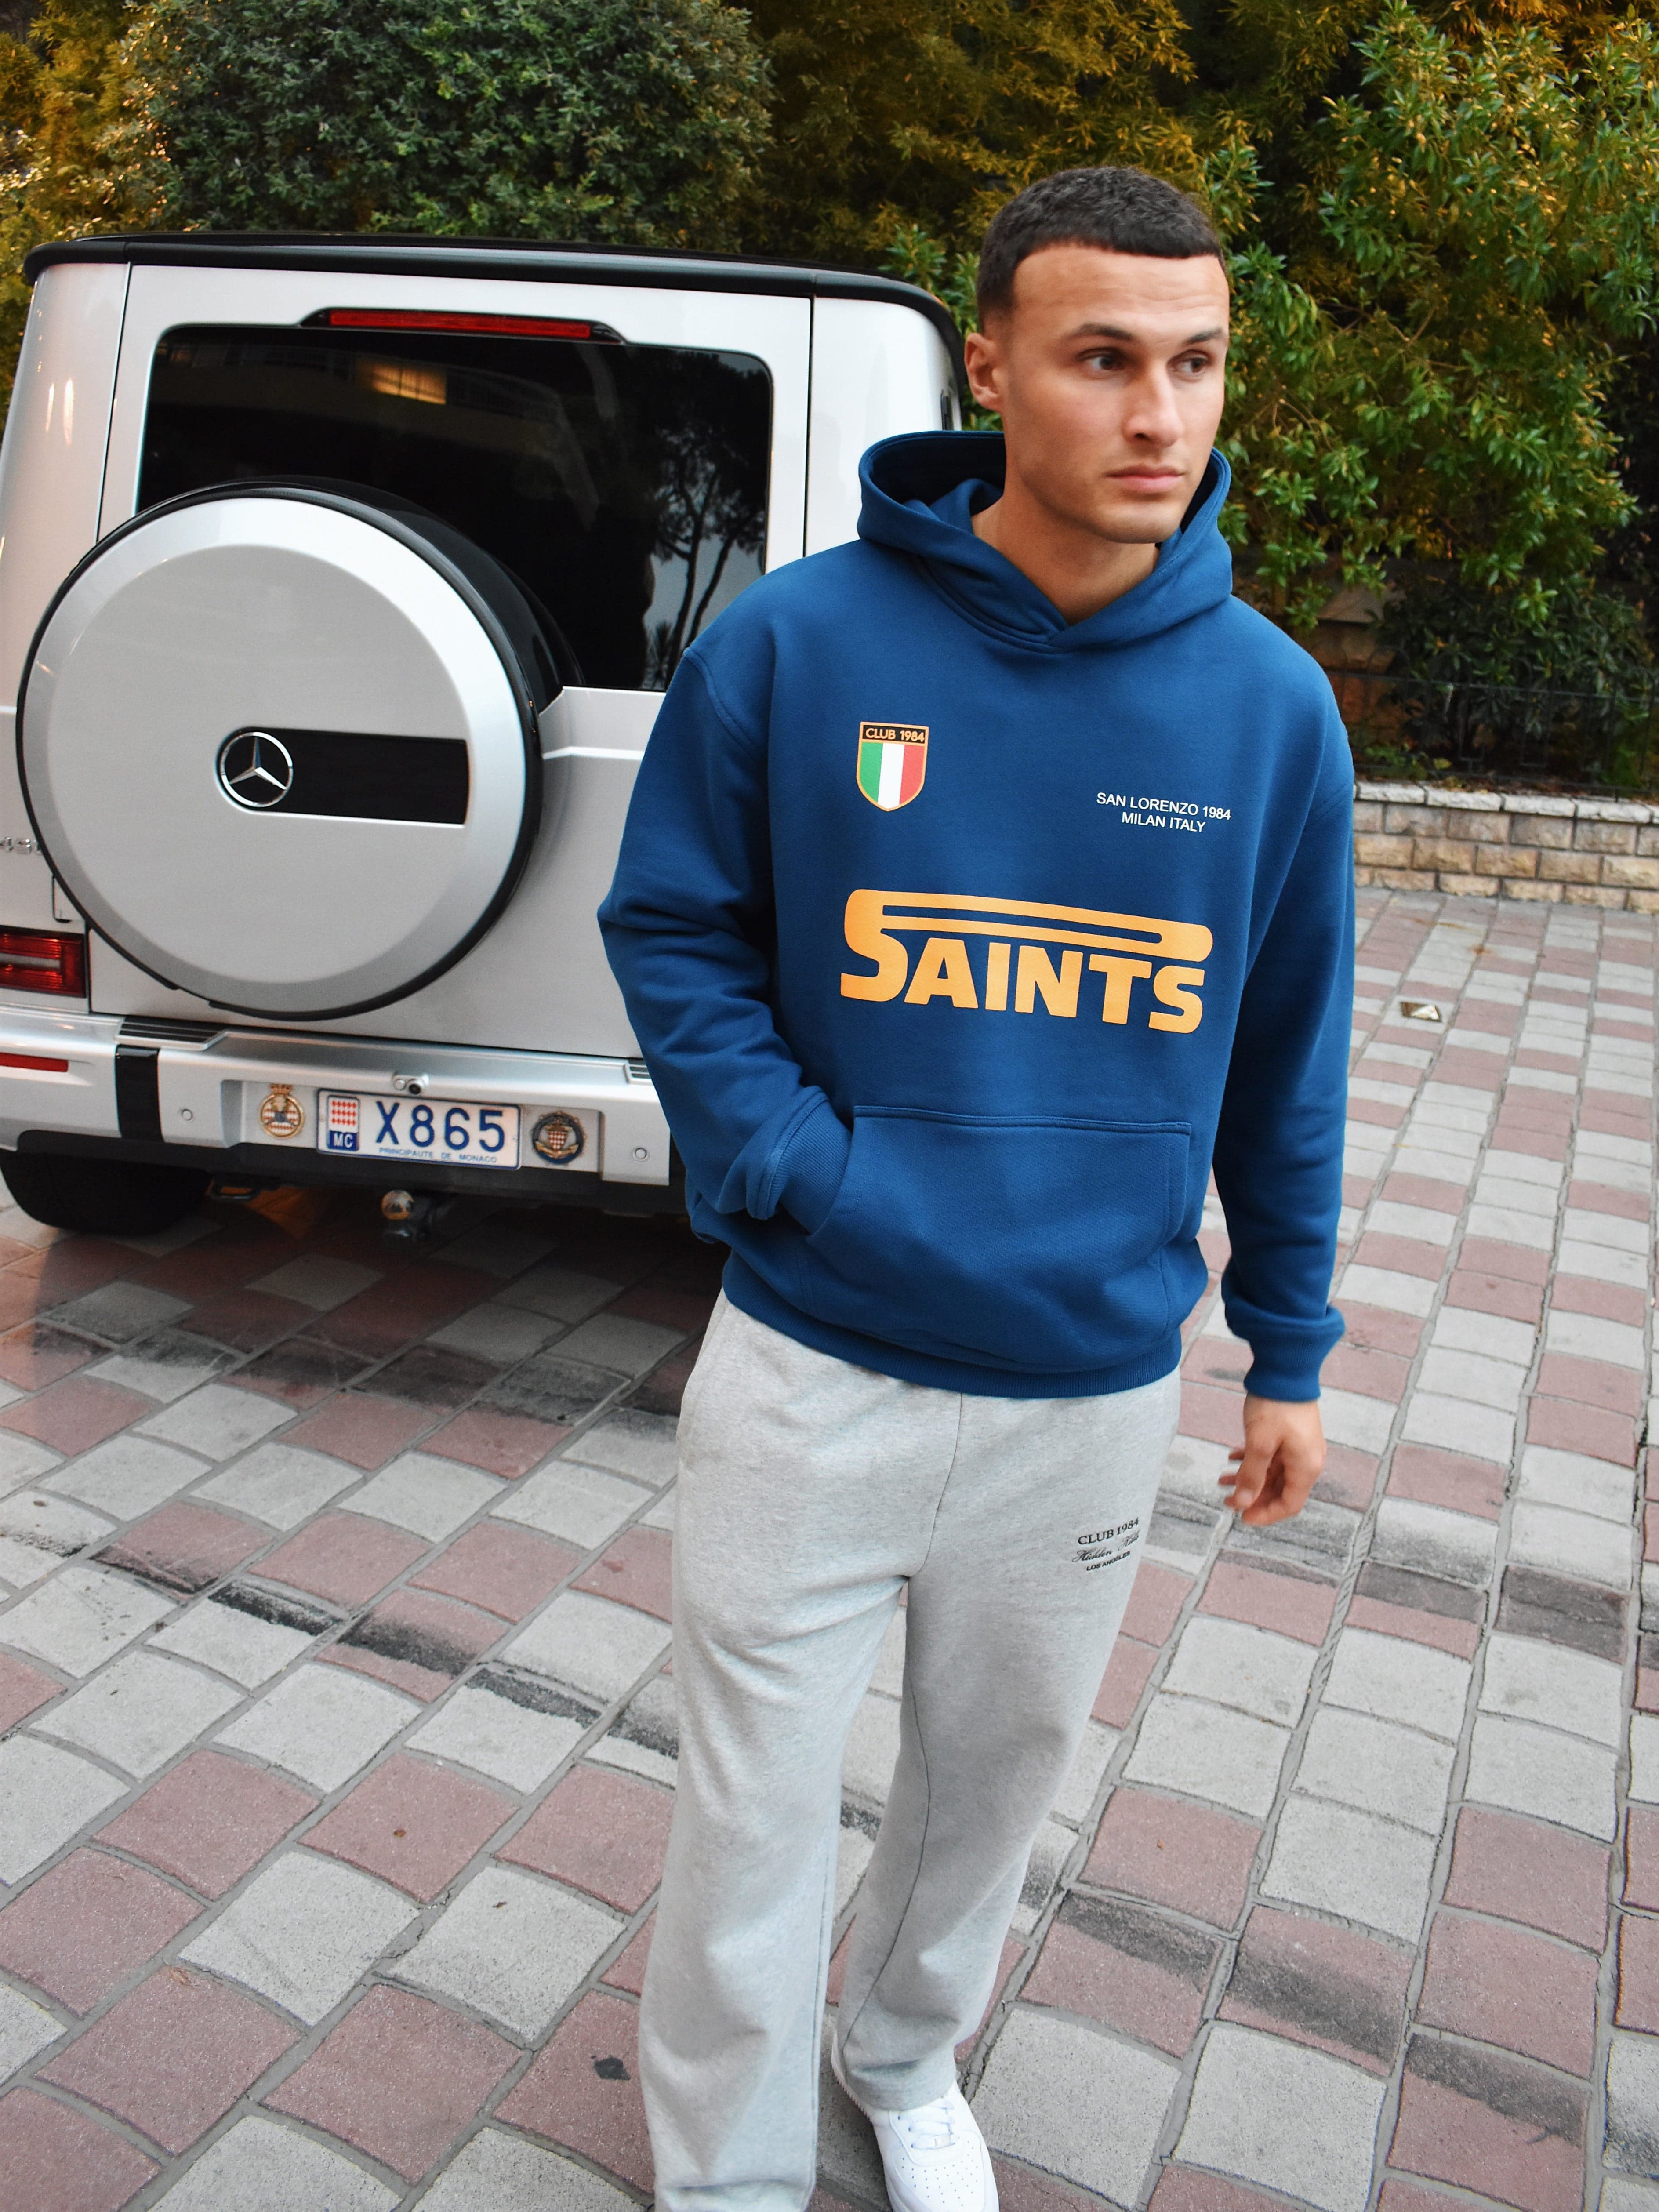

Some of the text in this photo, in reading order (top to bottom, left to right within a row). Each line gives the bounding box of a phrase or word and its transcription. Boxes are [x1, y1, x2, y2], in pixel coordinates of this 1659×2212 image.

[865, 728, 925, 742] CLUB 1984
[1096, 792, 1231, 820] SAN LORENZO 1984
[1122, 812, 1206, 832] MILAN ITALY
[841, 889, 1213, 1034] SAINTS
[376, 1101, 505, 1153] X865
[333, 1133, 353, 1148] MC
[379, 1147, 433, 1159] PRINCIPAUTE
[459, 1154, 497, 1163] MONACO
[1078, 1529, 1114, 1545] CLUB
[1117, 1517, 1139, 1535] 1984
